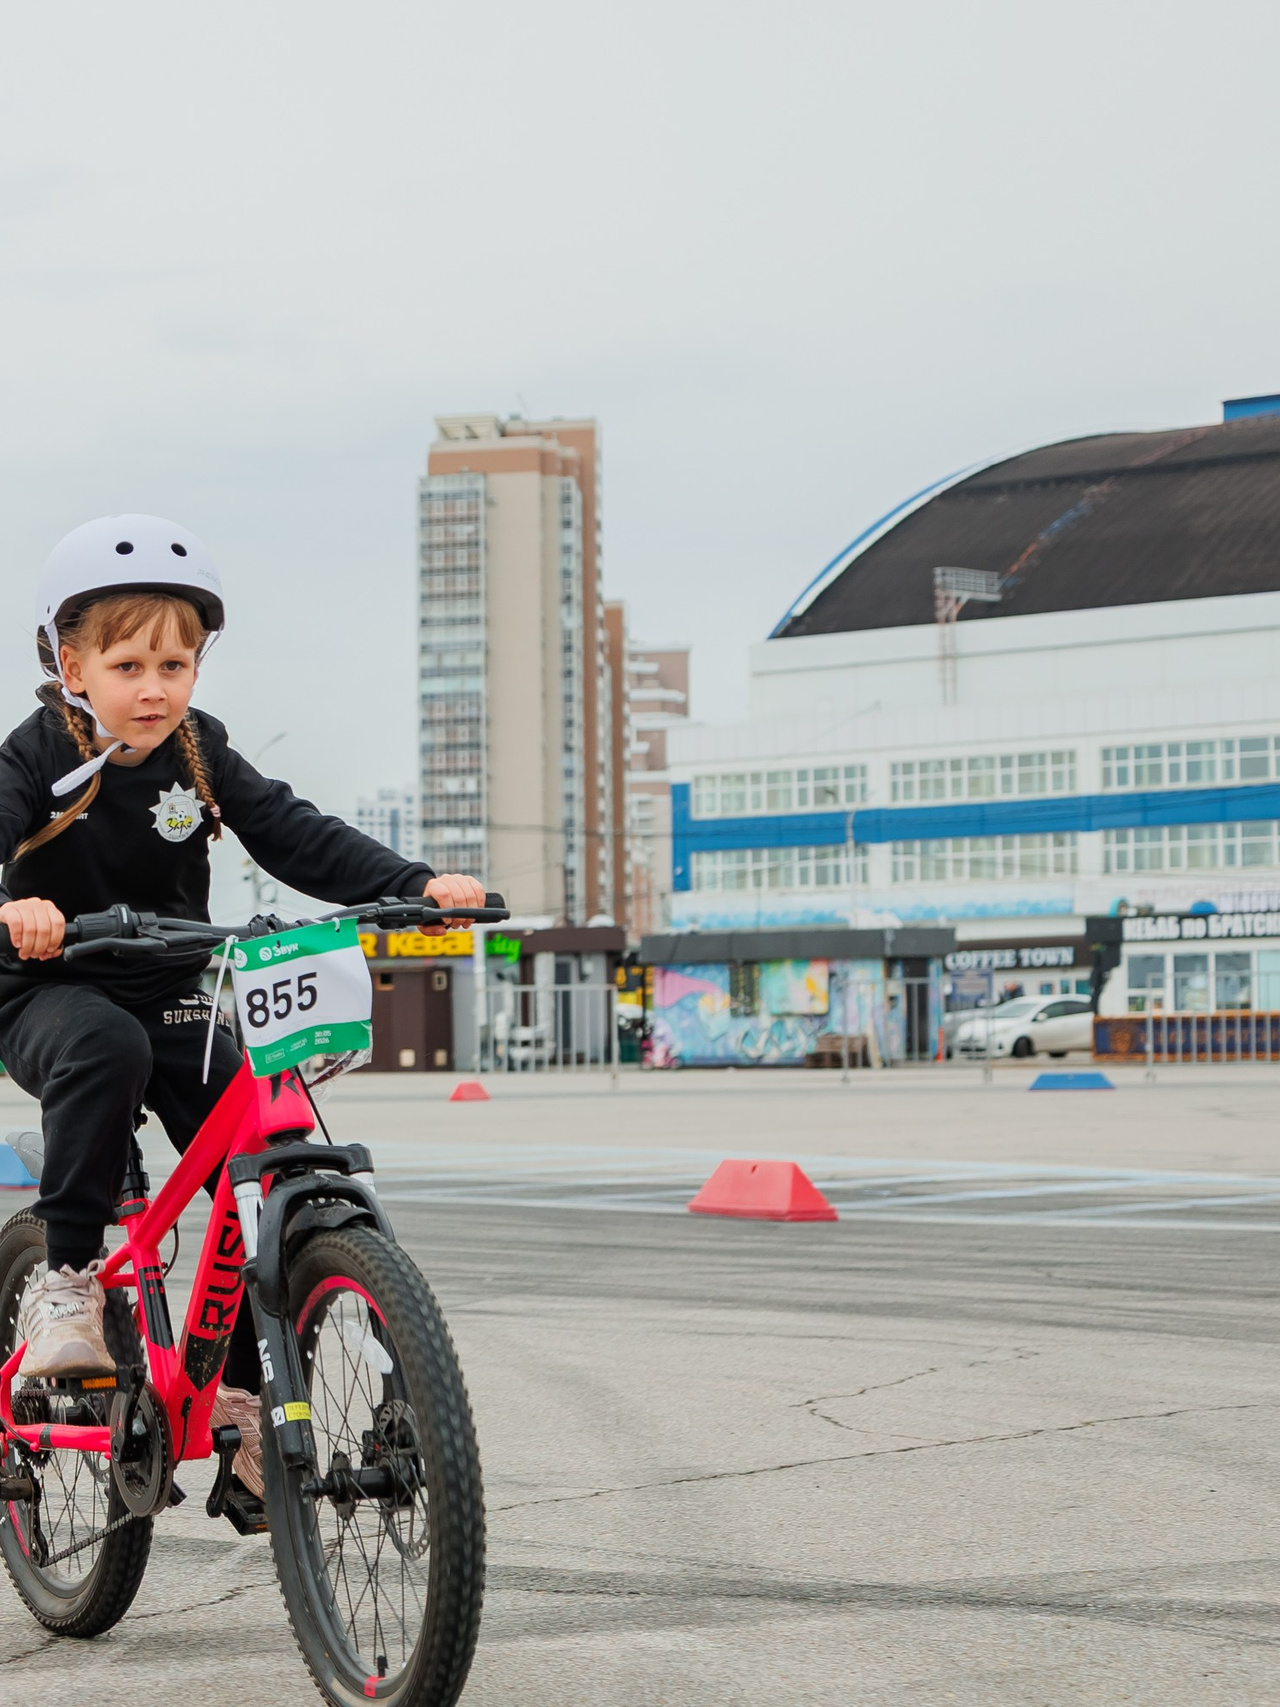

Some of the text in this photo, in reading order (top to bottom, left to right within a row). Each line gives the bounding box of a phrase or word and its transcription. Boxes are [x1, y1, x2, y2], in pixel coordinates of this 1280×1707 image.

[1122, 916, 1181, 942] КЕБАБ
[1208, 911, 1280, 938] БРАТСК
[945, 945, 1075, 971] COFFEE TOWN
[246, 971, 318, 1029] 855
[163, 1008, 231, 1027] SUNSHN
